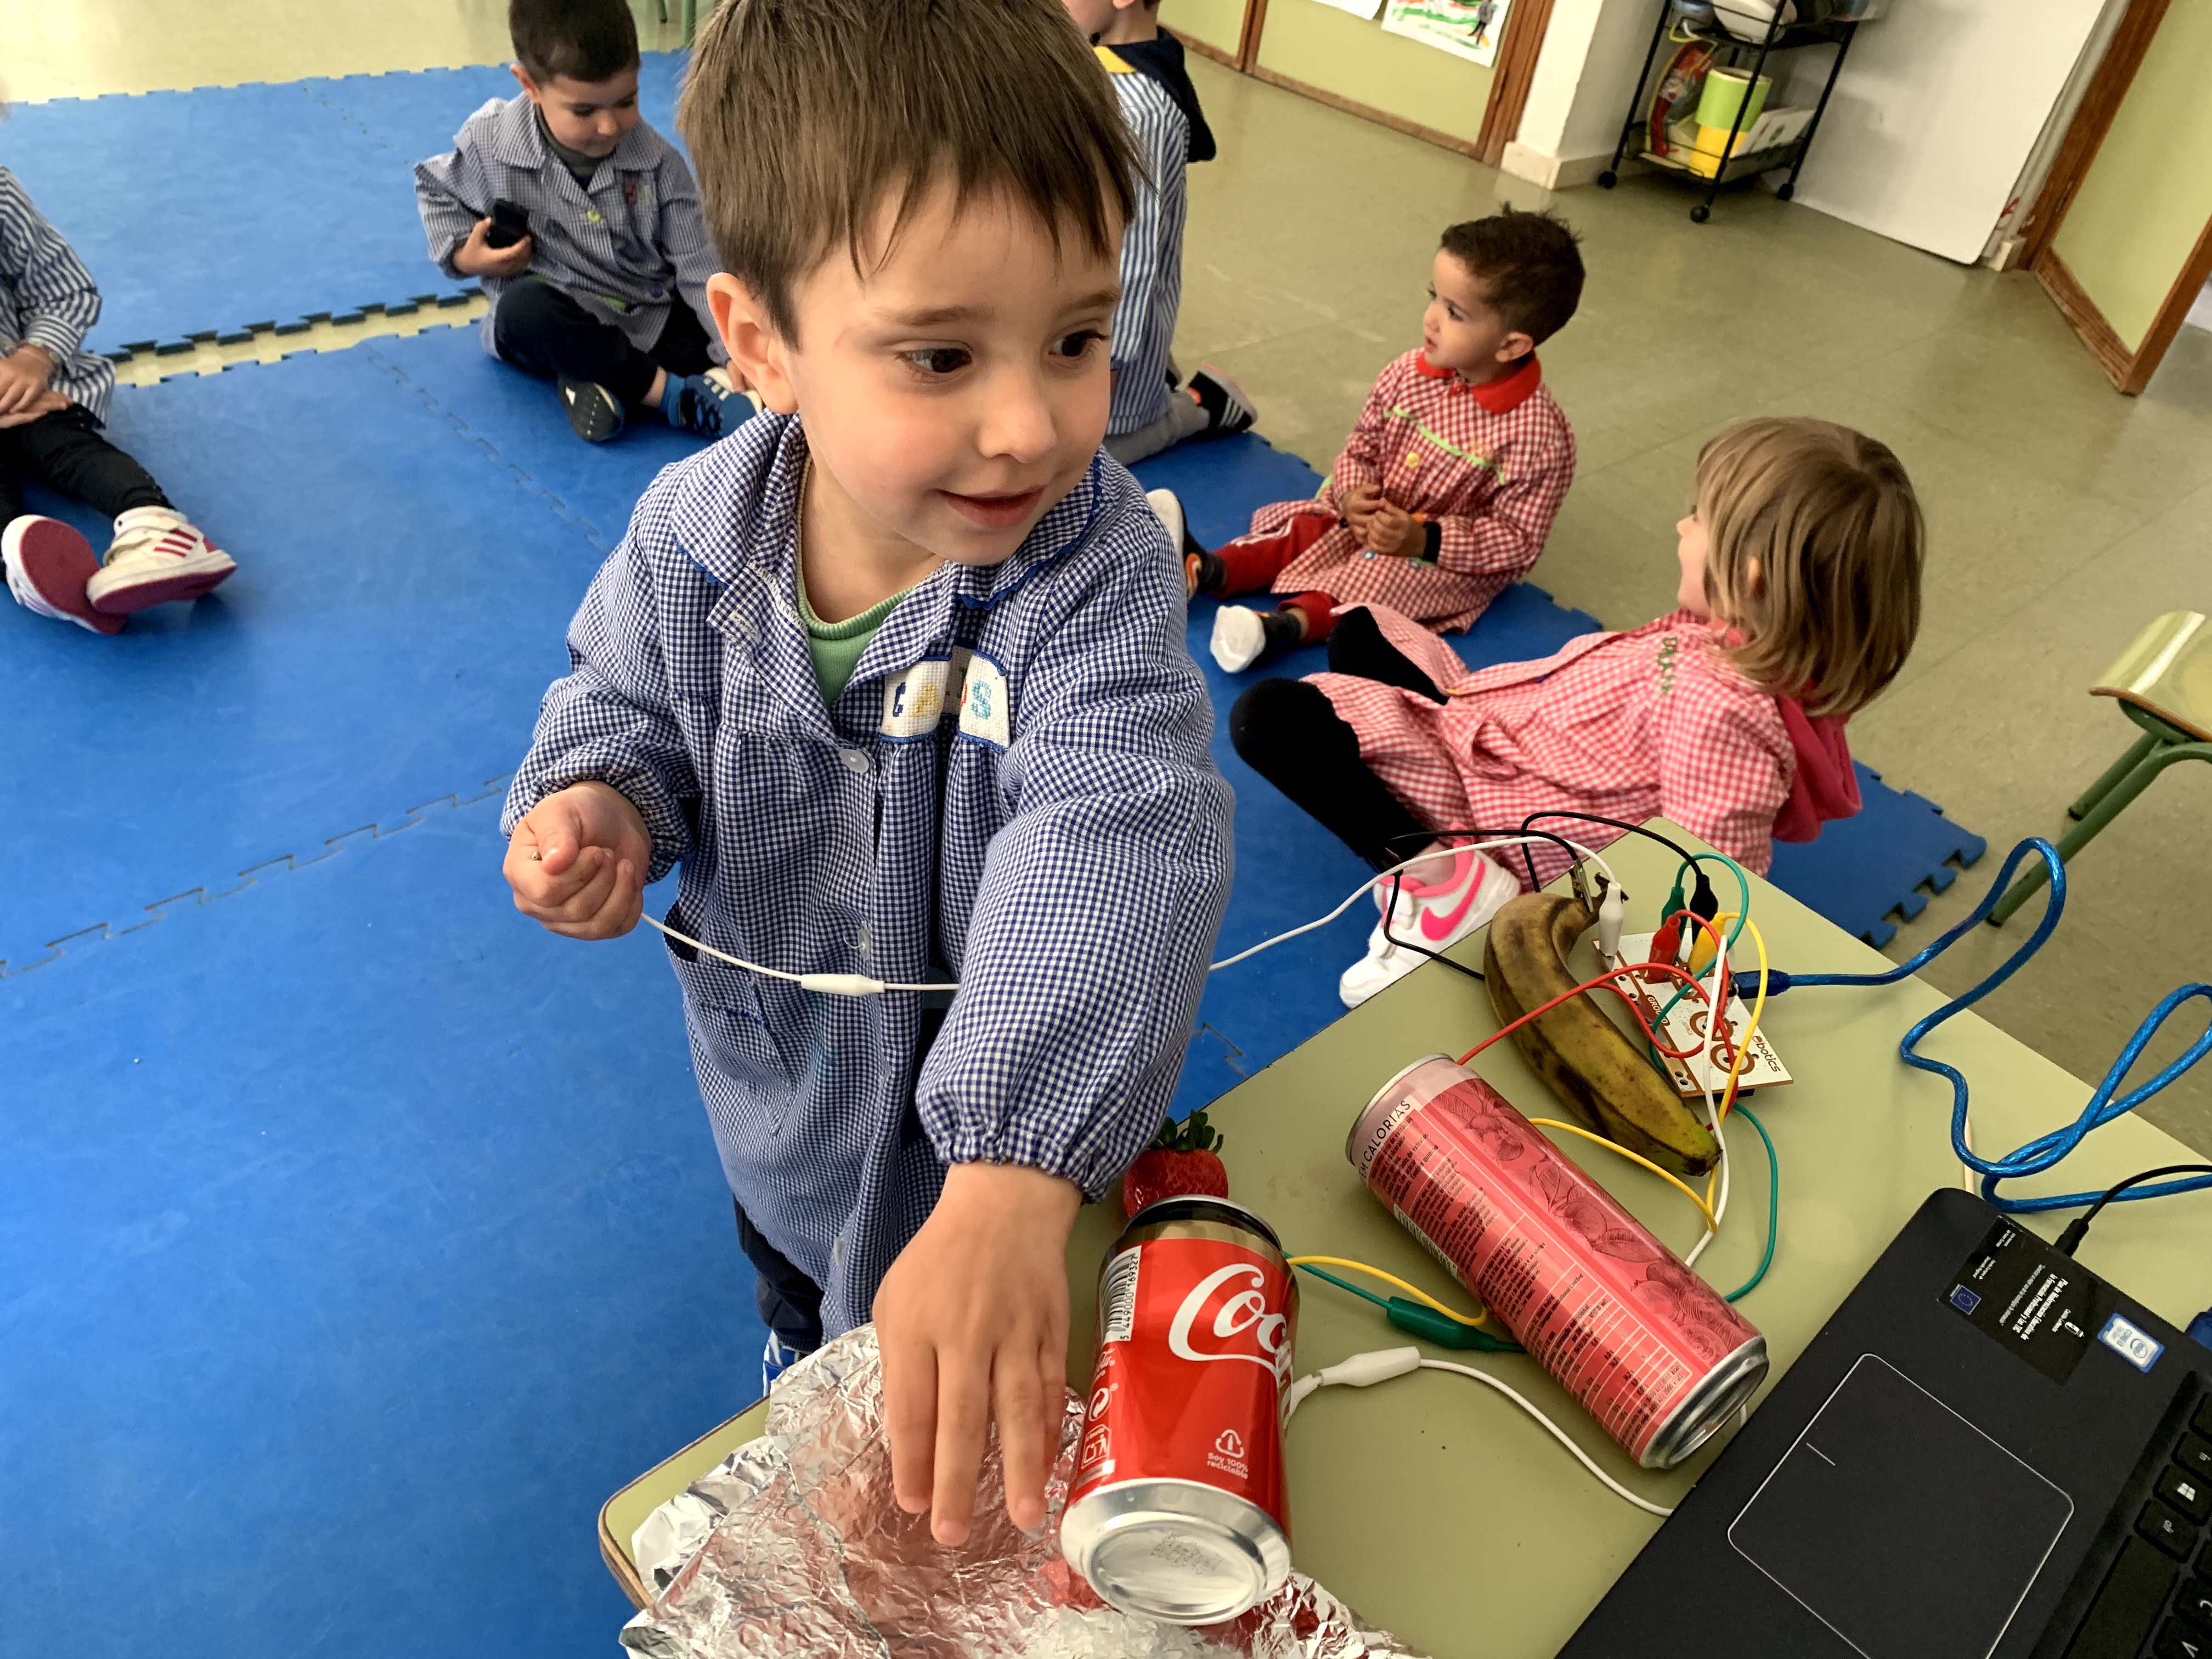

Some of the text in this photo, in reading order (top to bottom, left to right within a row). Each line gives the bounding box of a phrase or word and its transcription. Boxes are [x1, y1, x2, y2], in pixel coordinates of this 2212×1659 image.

[1647, 995, 1668, 1024] GROUD
[1681, 1021, 1694, 1036] SPACE
[1752, 1035, 1781, 1073] ebotics
[1364, 1100, 1410, 1161] CALORIAS
[1127, 1256, 1139, 1286] 169327
[1124, 1291, 1135, 1329] 449000
[1206, 1460, 1249, 1480] reciclable
[1207, 1452, 1249, 1472] Soy 100%
